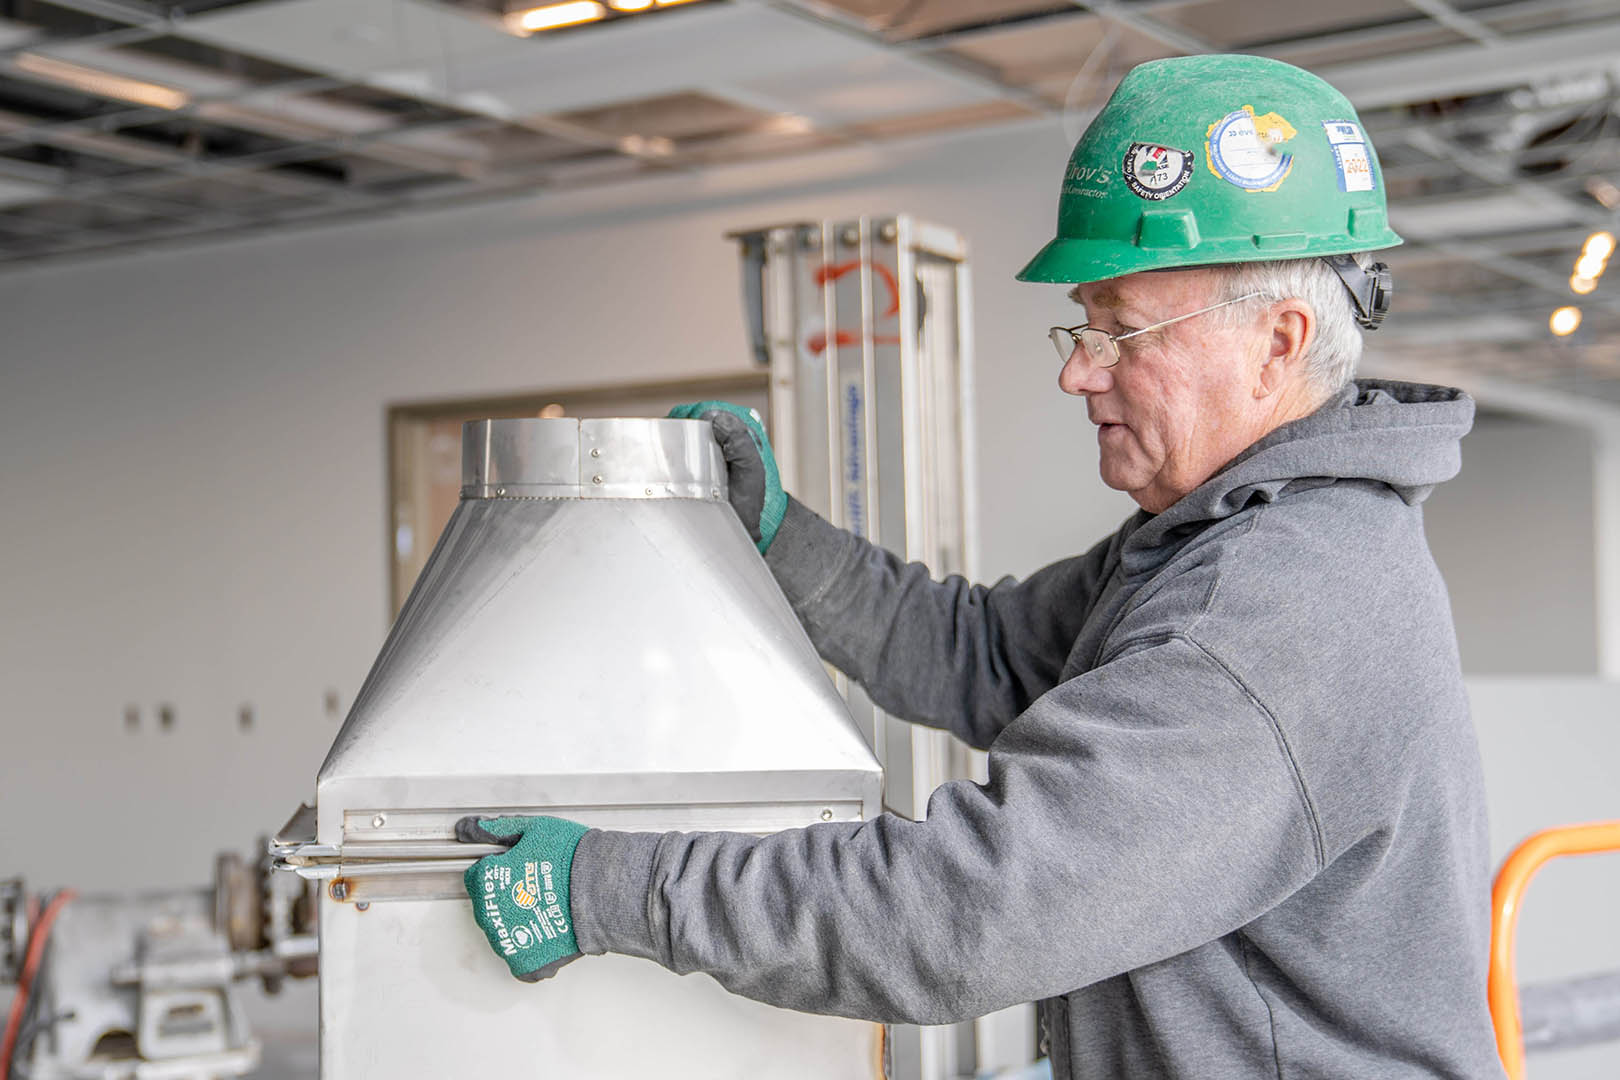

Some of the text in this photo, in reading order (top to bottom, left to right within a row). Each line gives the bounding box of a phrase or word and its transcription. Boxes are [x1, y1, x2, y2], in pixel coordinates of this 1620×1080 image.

[1131, 171, 1190, 201] SAFETY ORIENTATION
[484, 867, 517, 955] MaxiFlex
